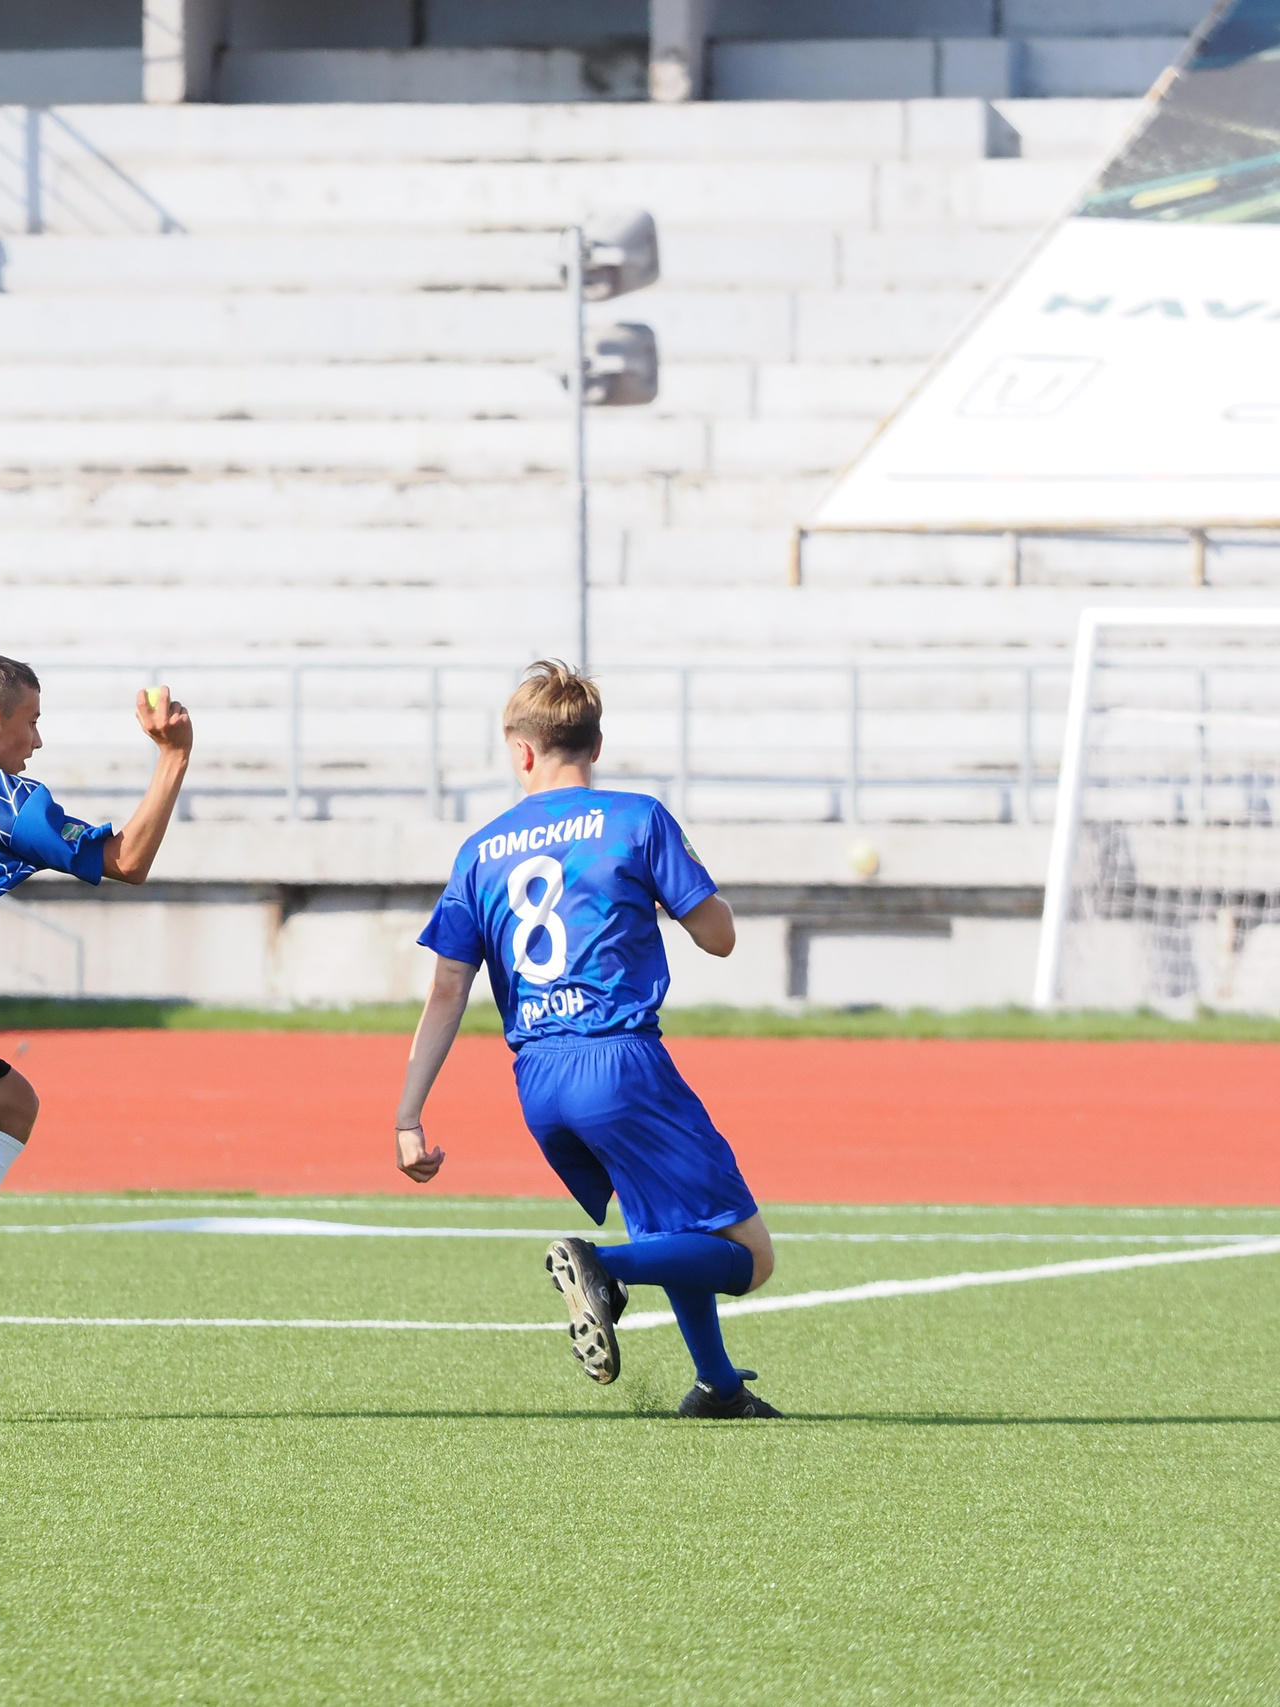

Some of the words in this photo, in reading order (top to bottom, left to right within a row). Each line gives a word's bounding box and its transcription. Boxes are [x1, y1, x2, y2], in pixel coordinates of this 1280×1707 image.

[1040, 292, 1280, 320] HAV
[477, 808, 605, 863] ТОМСКИЙ
[507, 855, 567, 985] 8
